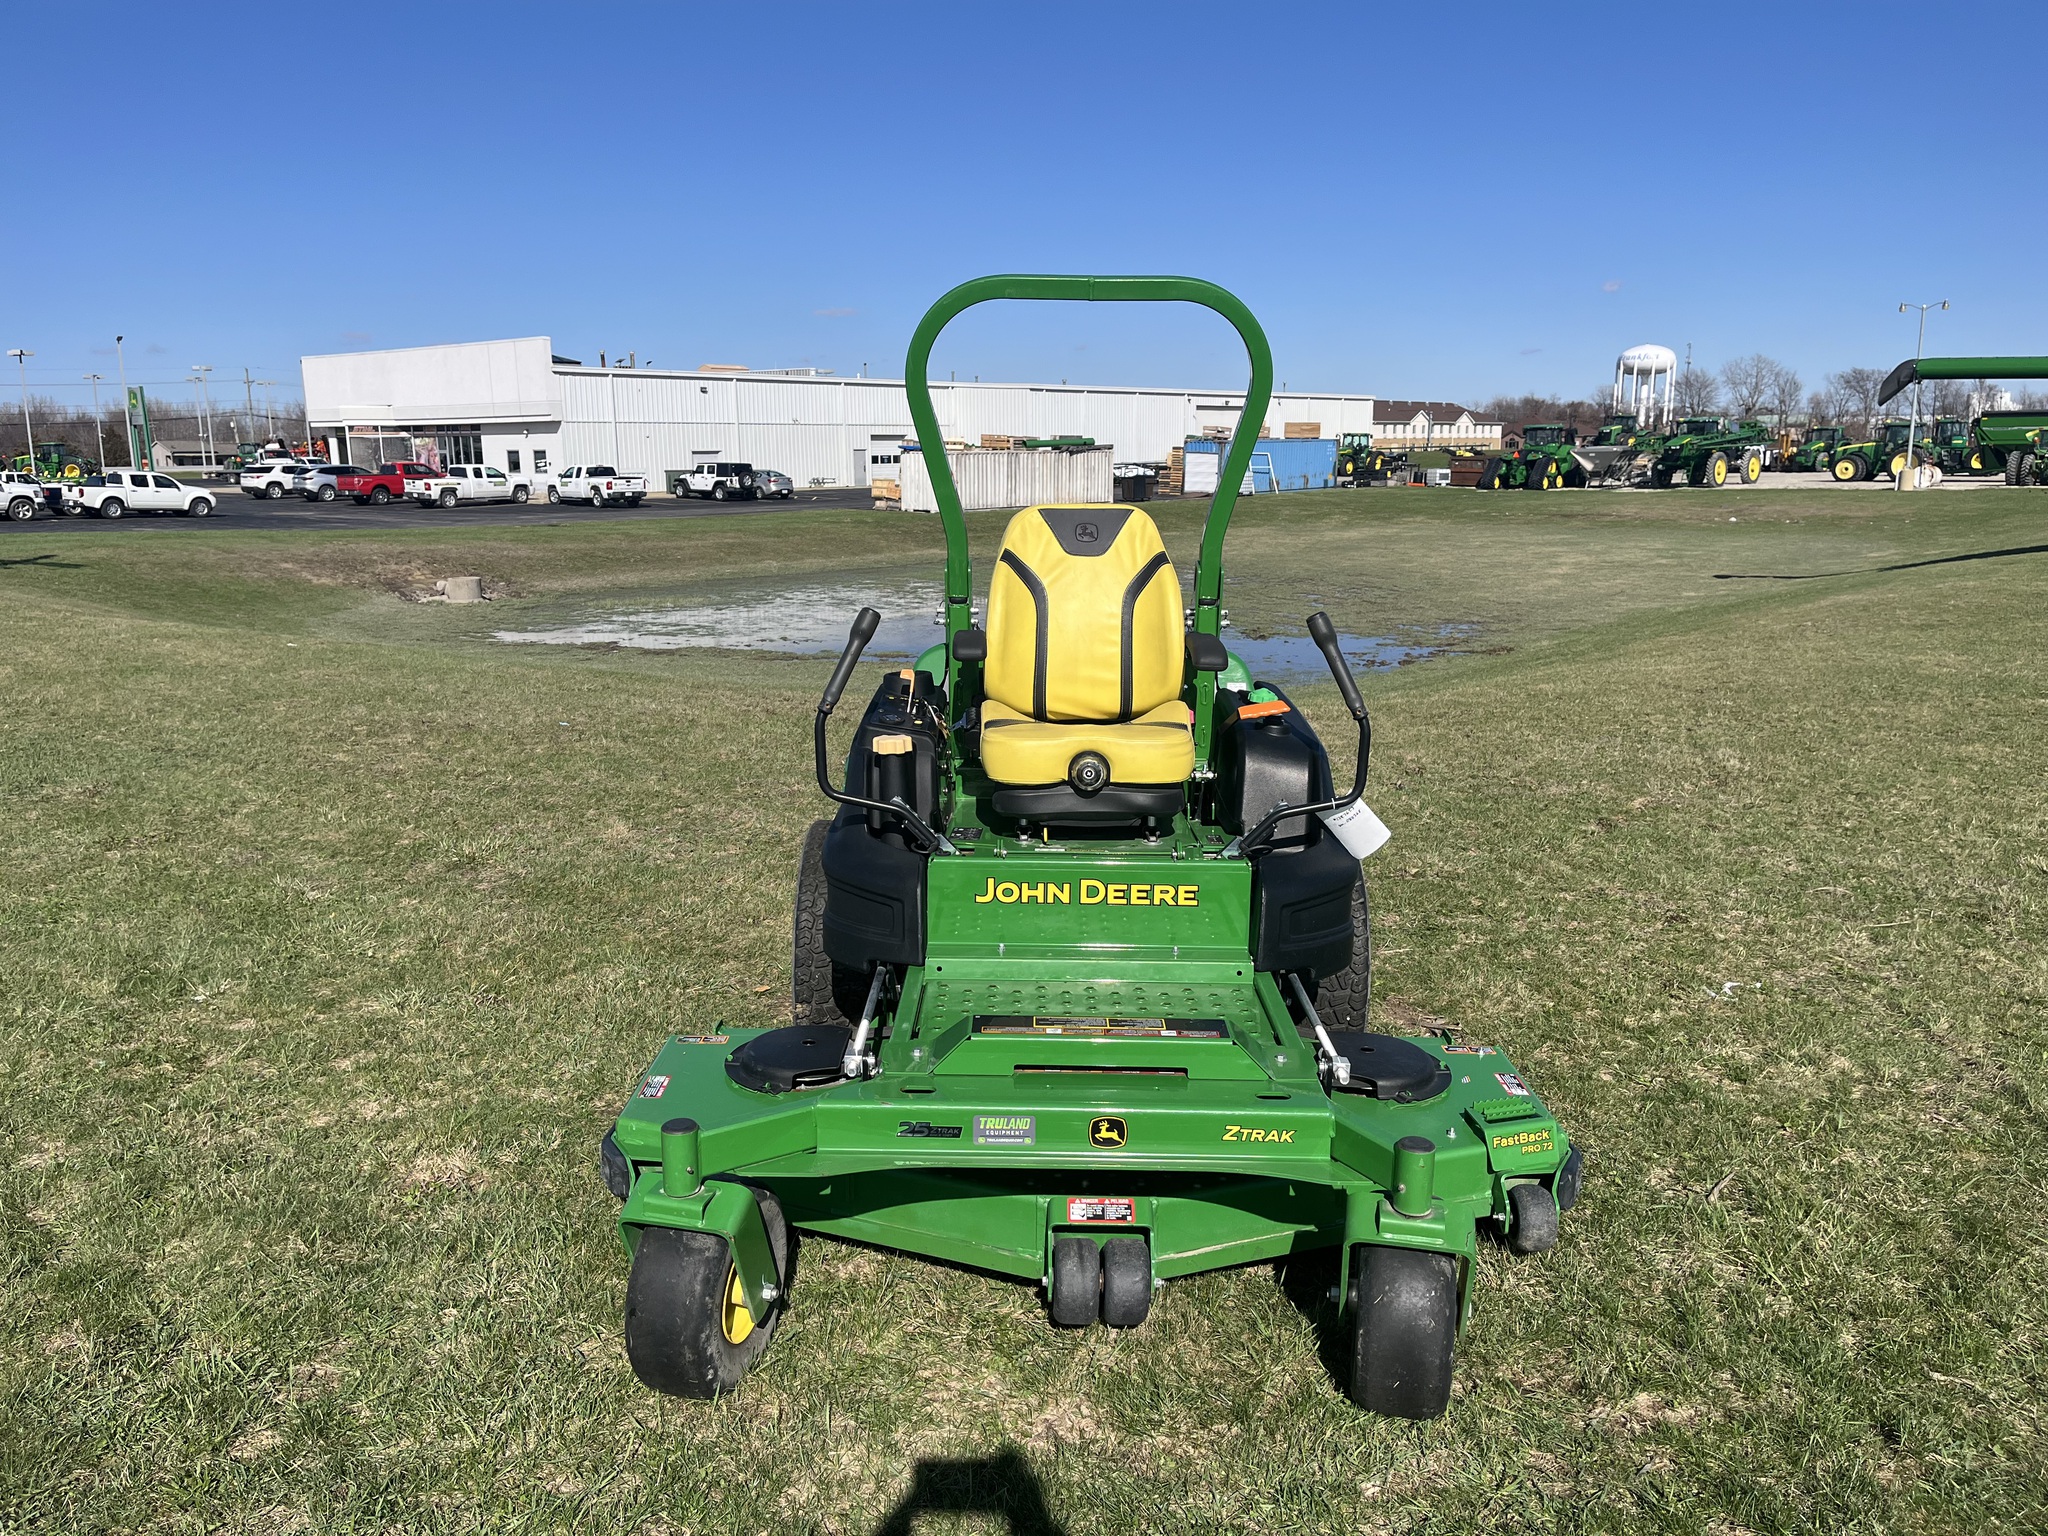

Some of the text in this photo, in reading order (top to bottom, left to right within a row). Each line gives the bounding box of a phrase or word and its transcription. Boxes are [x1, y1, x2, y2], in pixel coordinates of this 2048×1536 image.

[1621, 353, 1660, 361] rankfot
[975, 877, 1199, 907] JOHN DEERE
[897, 1121, 960, 1137] 25 ZTRAK
[979, 1117, 1031, 1130] TRULAND
[1222, 1125, 1297, 1143] ZTRAK
[1492, 1128, 1551, 1149] FastBack
[1521, 1142, 1553, 1155] PRO 72
